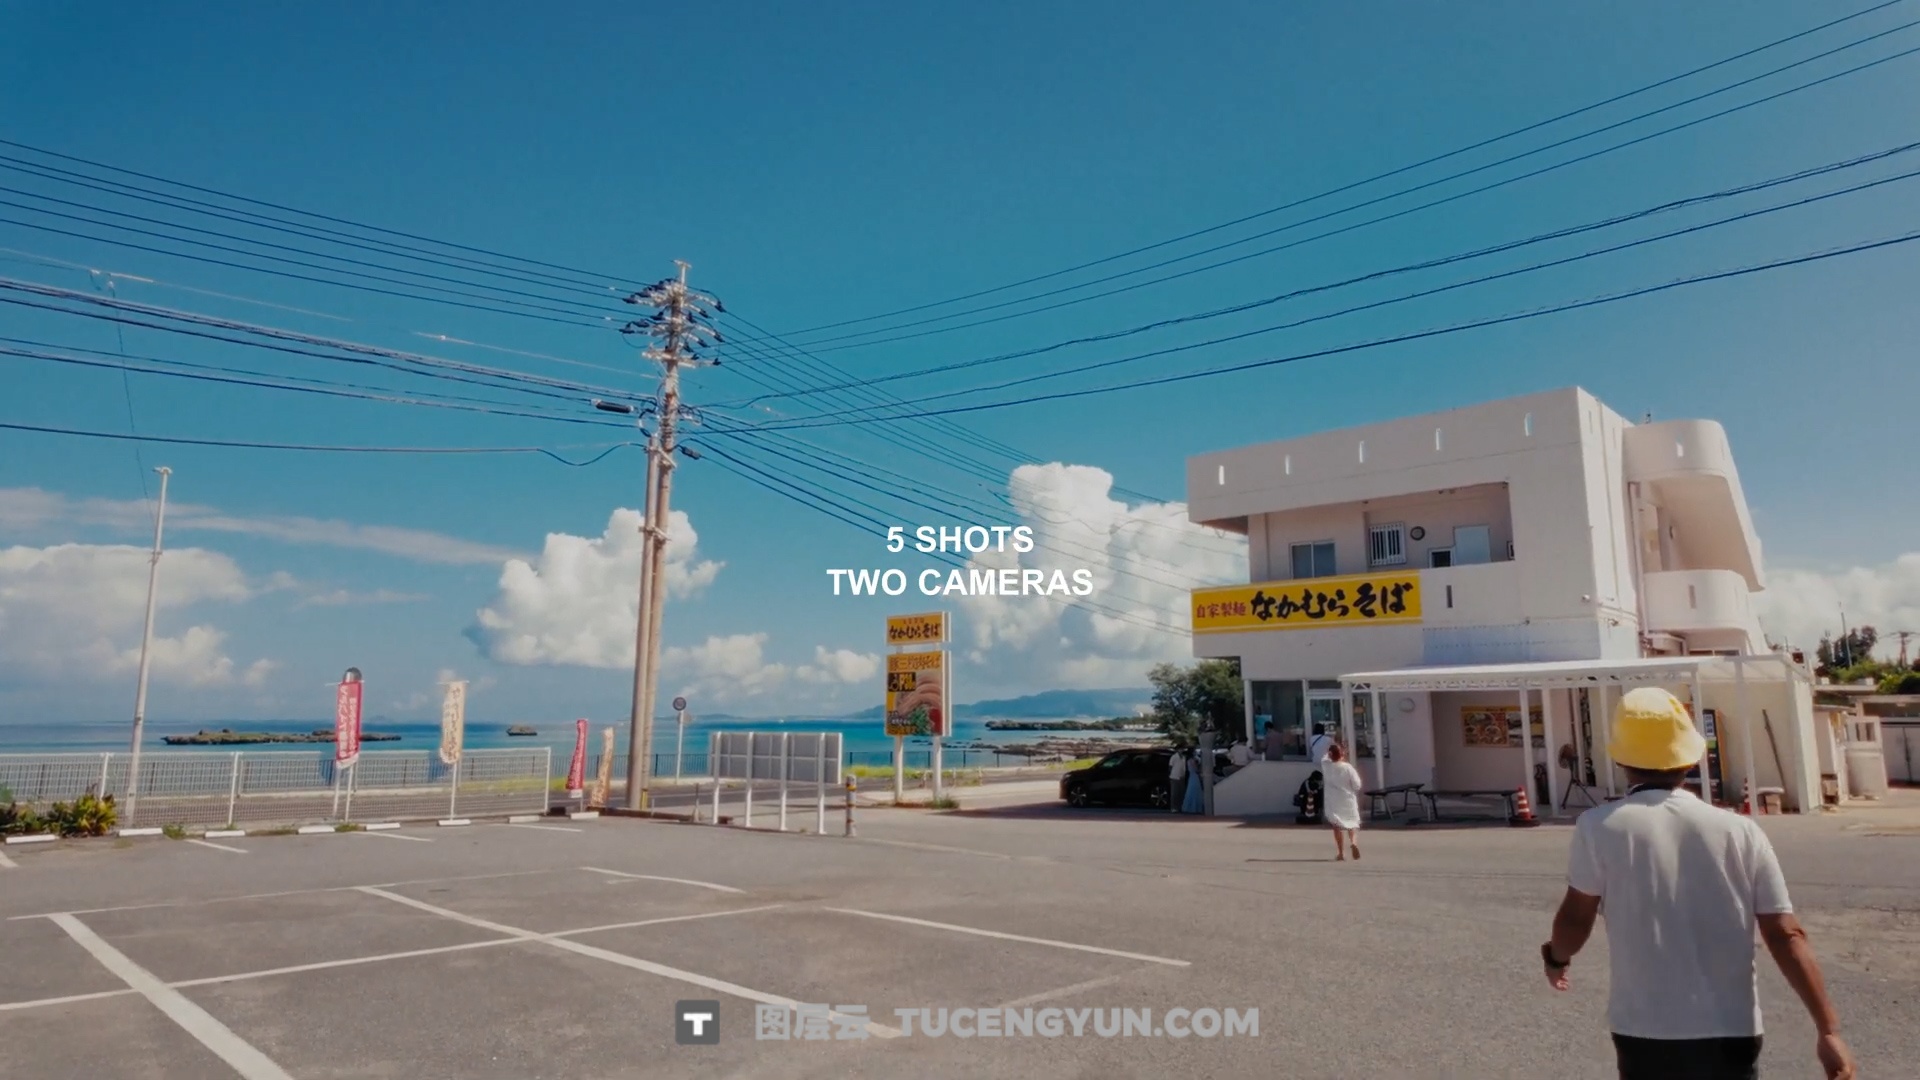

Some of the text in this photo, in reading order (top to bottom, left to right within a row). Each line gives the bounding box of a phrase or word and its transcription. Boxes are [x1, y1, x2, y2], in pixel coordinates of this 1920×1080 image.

[1250, 582, 1413, 621] なかむらそば
